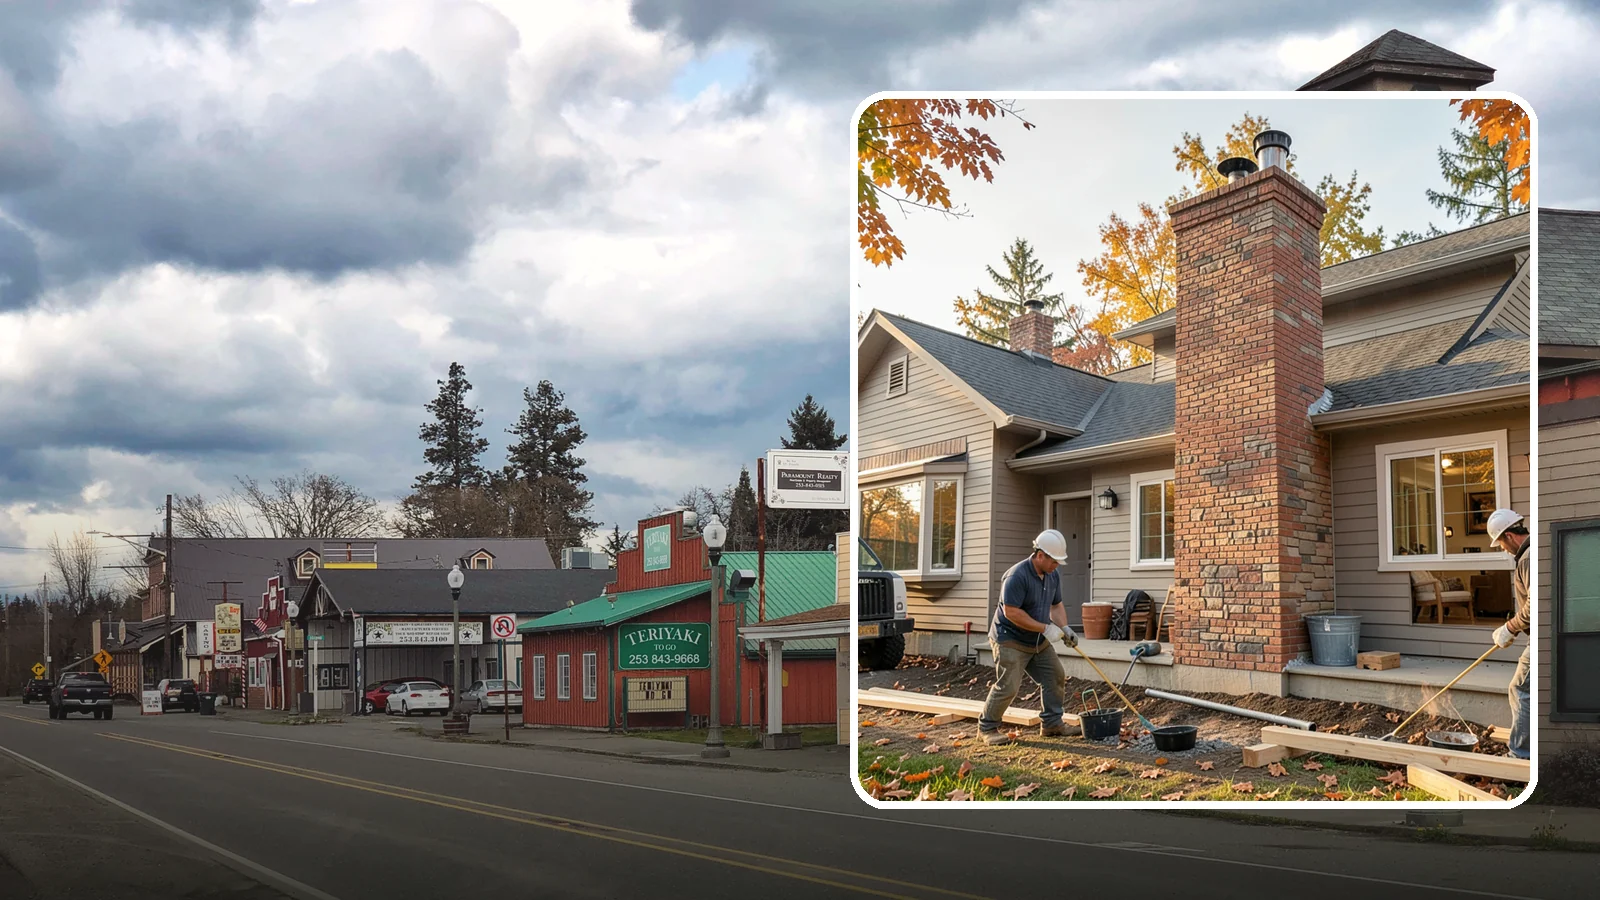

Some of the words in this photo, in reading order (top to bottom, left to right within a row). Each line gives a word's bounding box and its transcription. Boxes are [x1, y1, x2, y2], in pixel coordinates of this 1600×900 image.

[625, 627, 702, 646] TERIYAKI
[629, 654, 648, 664] 253
[652, 654, 700, 664] 843-9668
